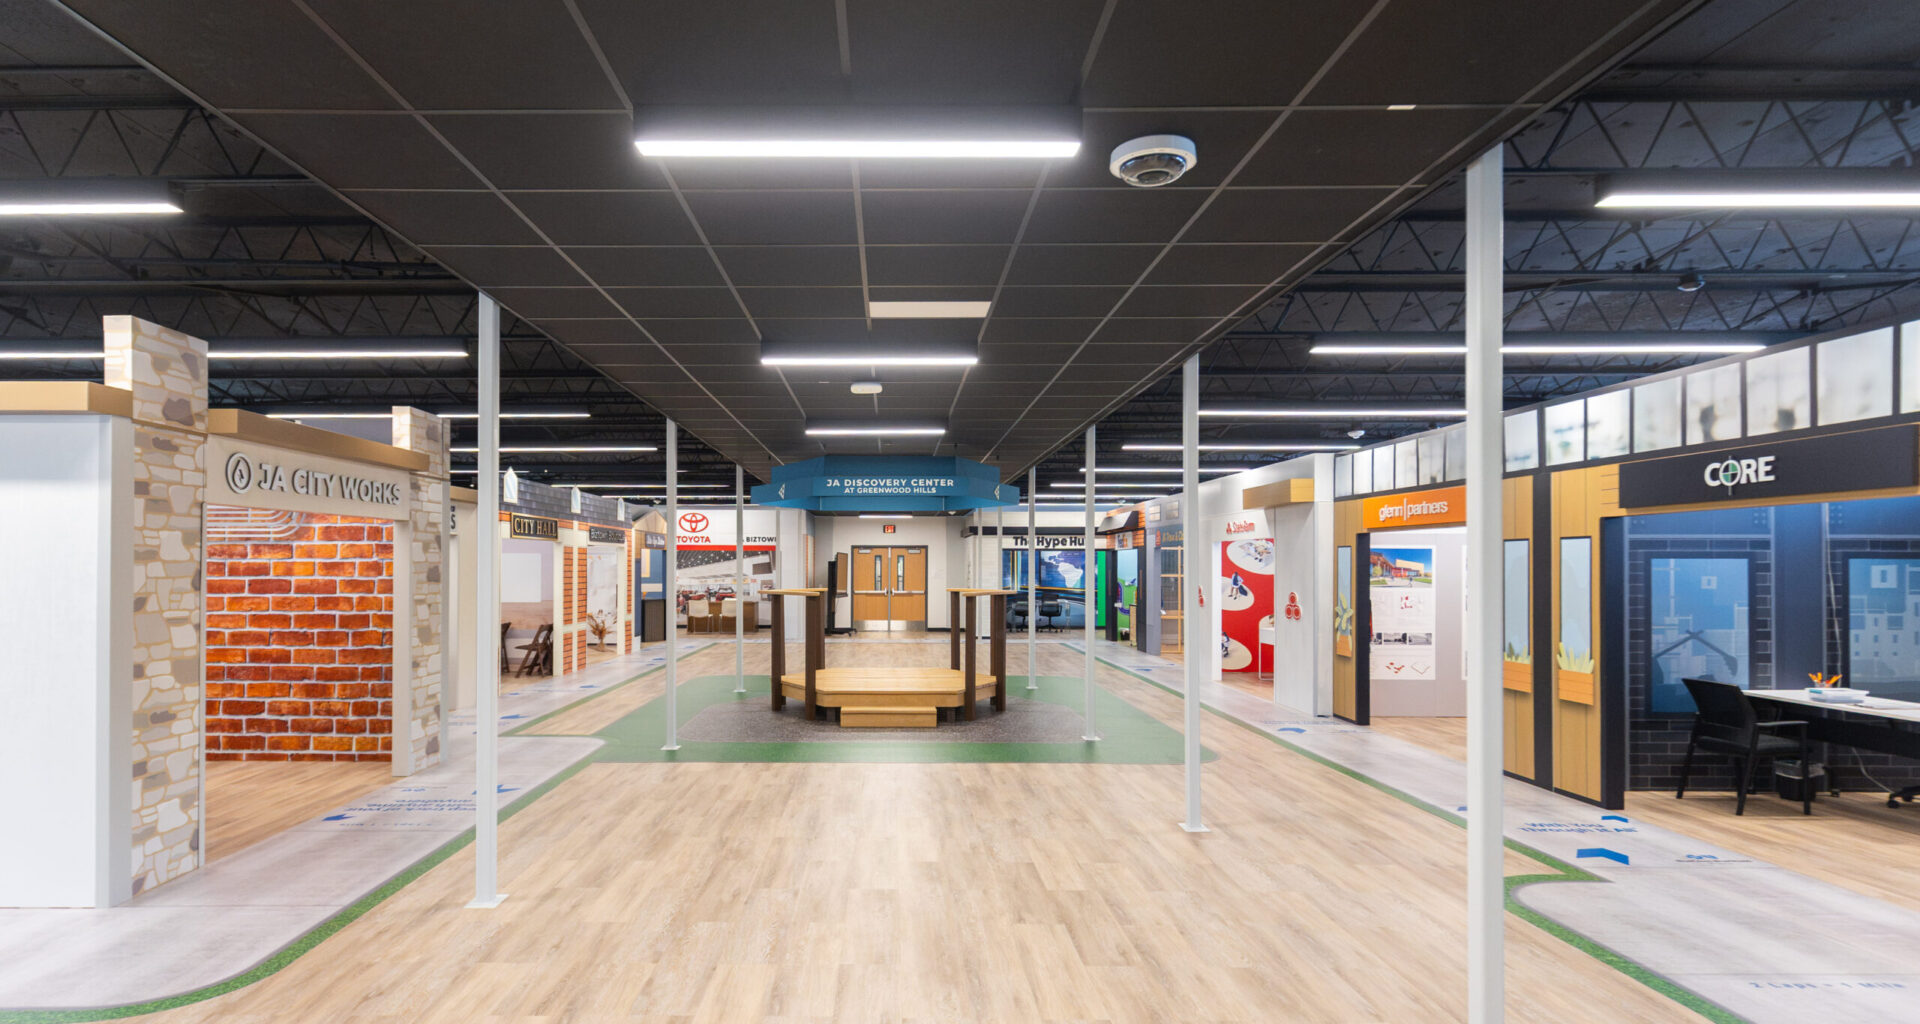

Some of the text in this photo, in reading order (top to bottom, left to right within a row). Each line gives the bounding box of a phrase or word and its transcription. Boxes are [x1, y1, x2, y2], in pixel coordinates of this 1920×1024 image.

[1704, 456, 1776, 487] CORE
[258, 463, 400, 505] JA CITY WORKS
[826, 479, 954, 487] JA DISCOVERY CENTER
[514, 518, 557, 536] CITY HALL
[1013, 536, 1085, 548] Th Hype Hu
